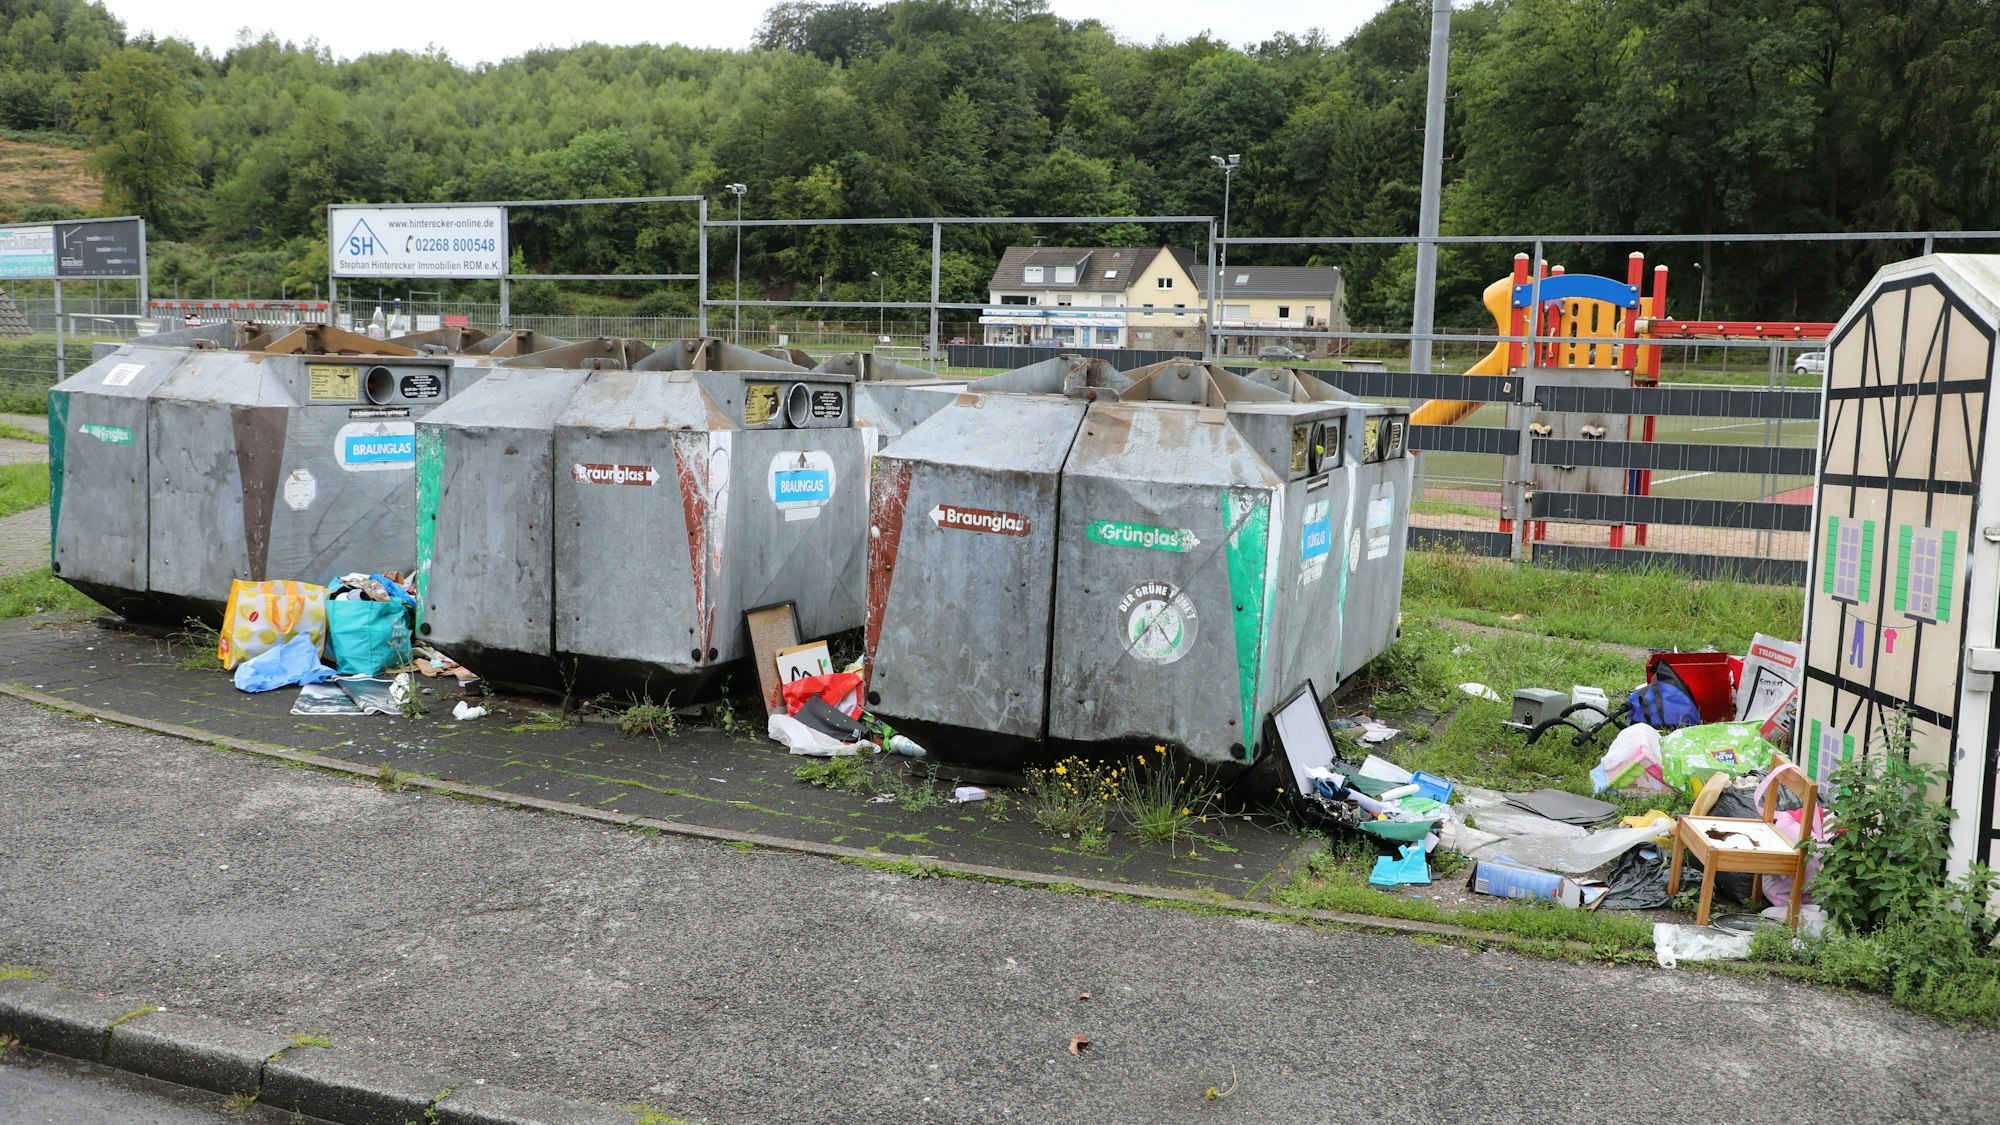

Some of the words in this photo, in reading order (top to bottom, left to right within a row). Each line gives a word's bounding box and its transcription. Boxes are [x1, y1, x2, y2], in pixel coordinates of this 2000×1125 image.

[388, 218, 494, 229] www.hinterecker-online.de
[350, 236, 374, 256] SH
[415, 238, 449, 251] 02268
[453, 238, 495, 251] 800548
[339, 260, 370, 272] Stephan
[371, 260, 415, 270] Hinterecker
[418, 261, 462, 271] Immobilien
[463, 261, 482, 270] RDM
[484, 261, 500, 270] e.K.
[352, 442, 412, 456] BRAUNGLAS
[578, 465, 645, 484] Braunglas
[780, 479, 824, 493] BRAUNGLAS
[946, 508, 1024, 532] Braunglas
[1101, 523, 1179, 547] Grünglas
[1118, 593, 1136, 613] DER
[1135, 582, 1168, 598] GRÜNE
[1758, 647, 1793, 665] TELEFUNKEN
[1765, 688, 1775, 696] TV
